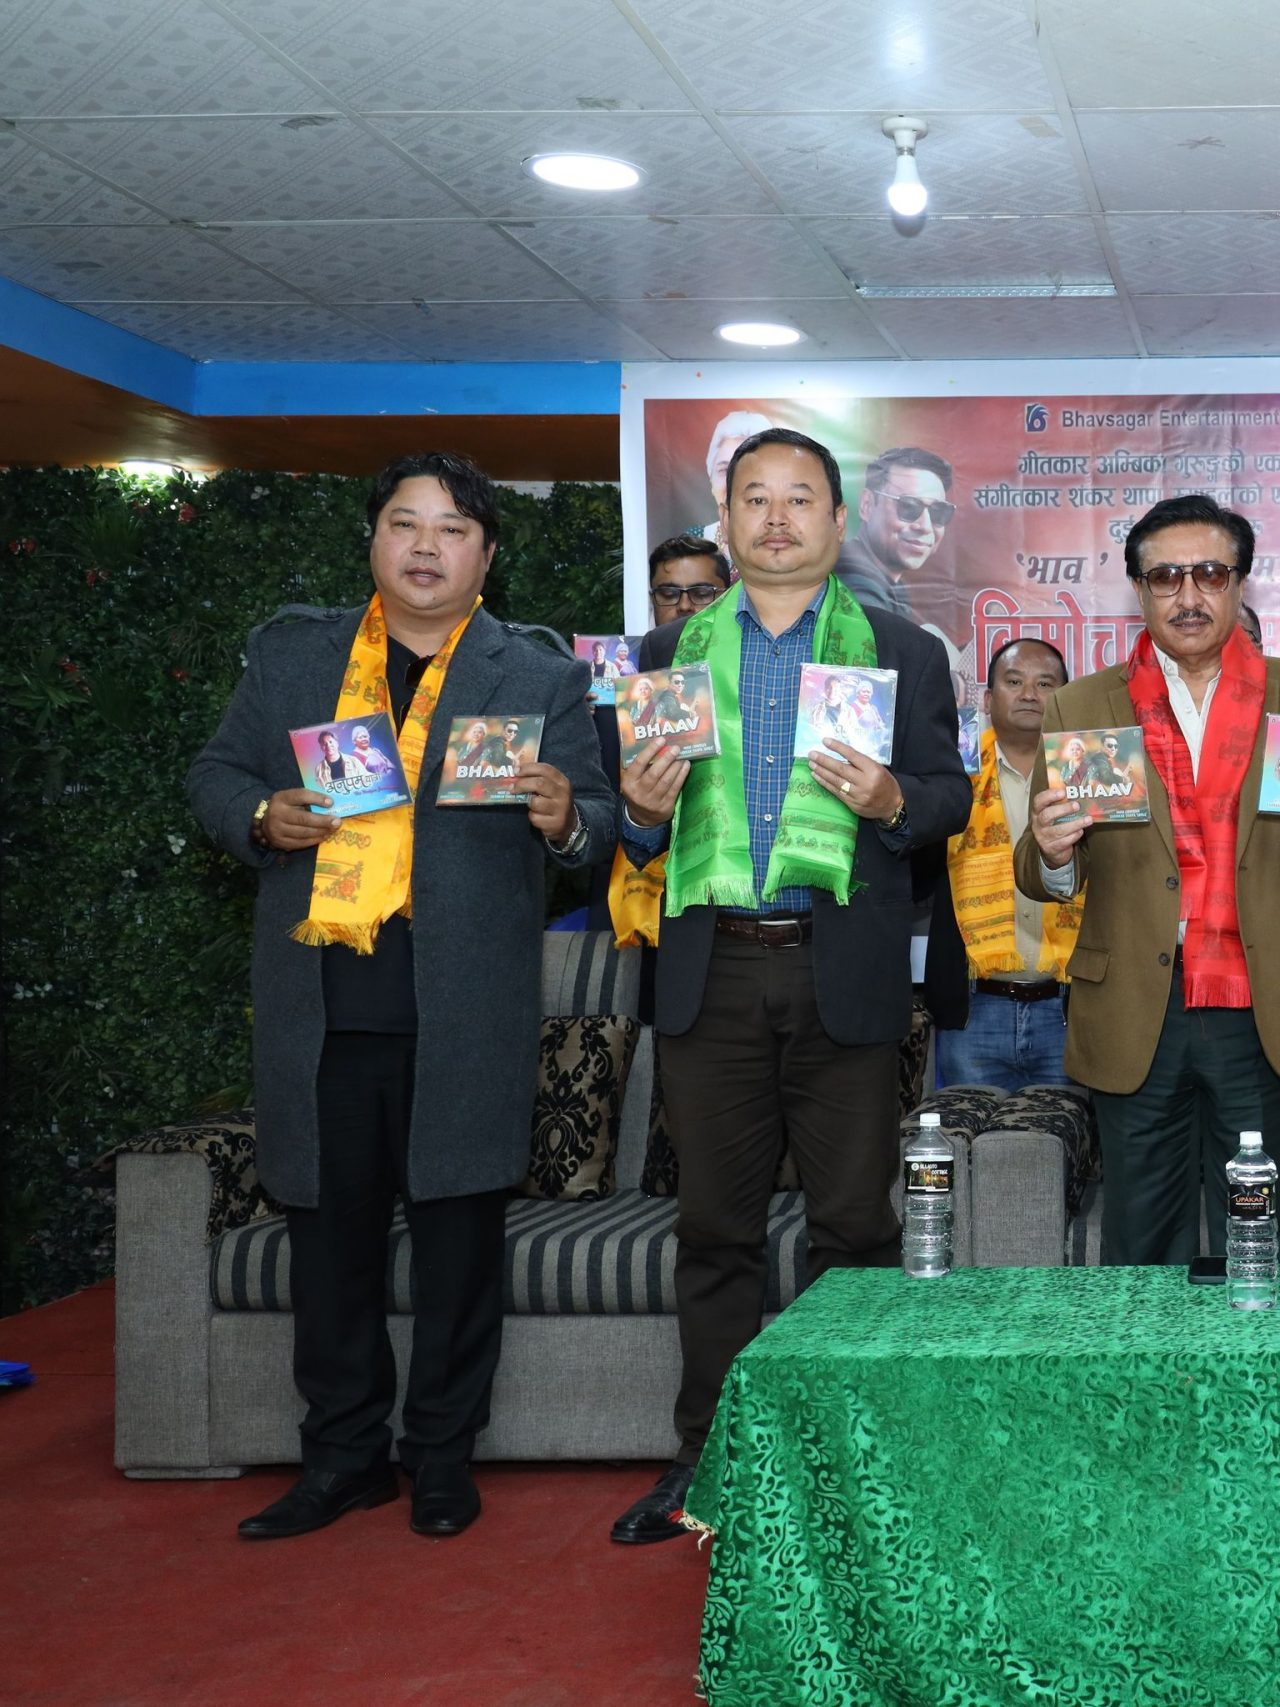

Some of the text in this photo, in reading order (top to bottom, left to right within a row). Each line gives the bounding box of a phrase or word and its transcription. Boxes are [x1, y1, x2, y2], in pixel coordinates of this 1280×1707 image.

[1062, 410, 1153, 430] Bhavsagar
[1160, 408, 1279, 427] Entertainment
[1018, 450, 1090, 475] गीतकार
[974, 483, 1062, 509] संगीतकार
[1068, 486, 1116, 508] शंकर
[634, 716, 699, 740] BHAAV
[1066, 782, 1133, 799] BHAAV
